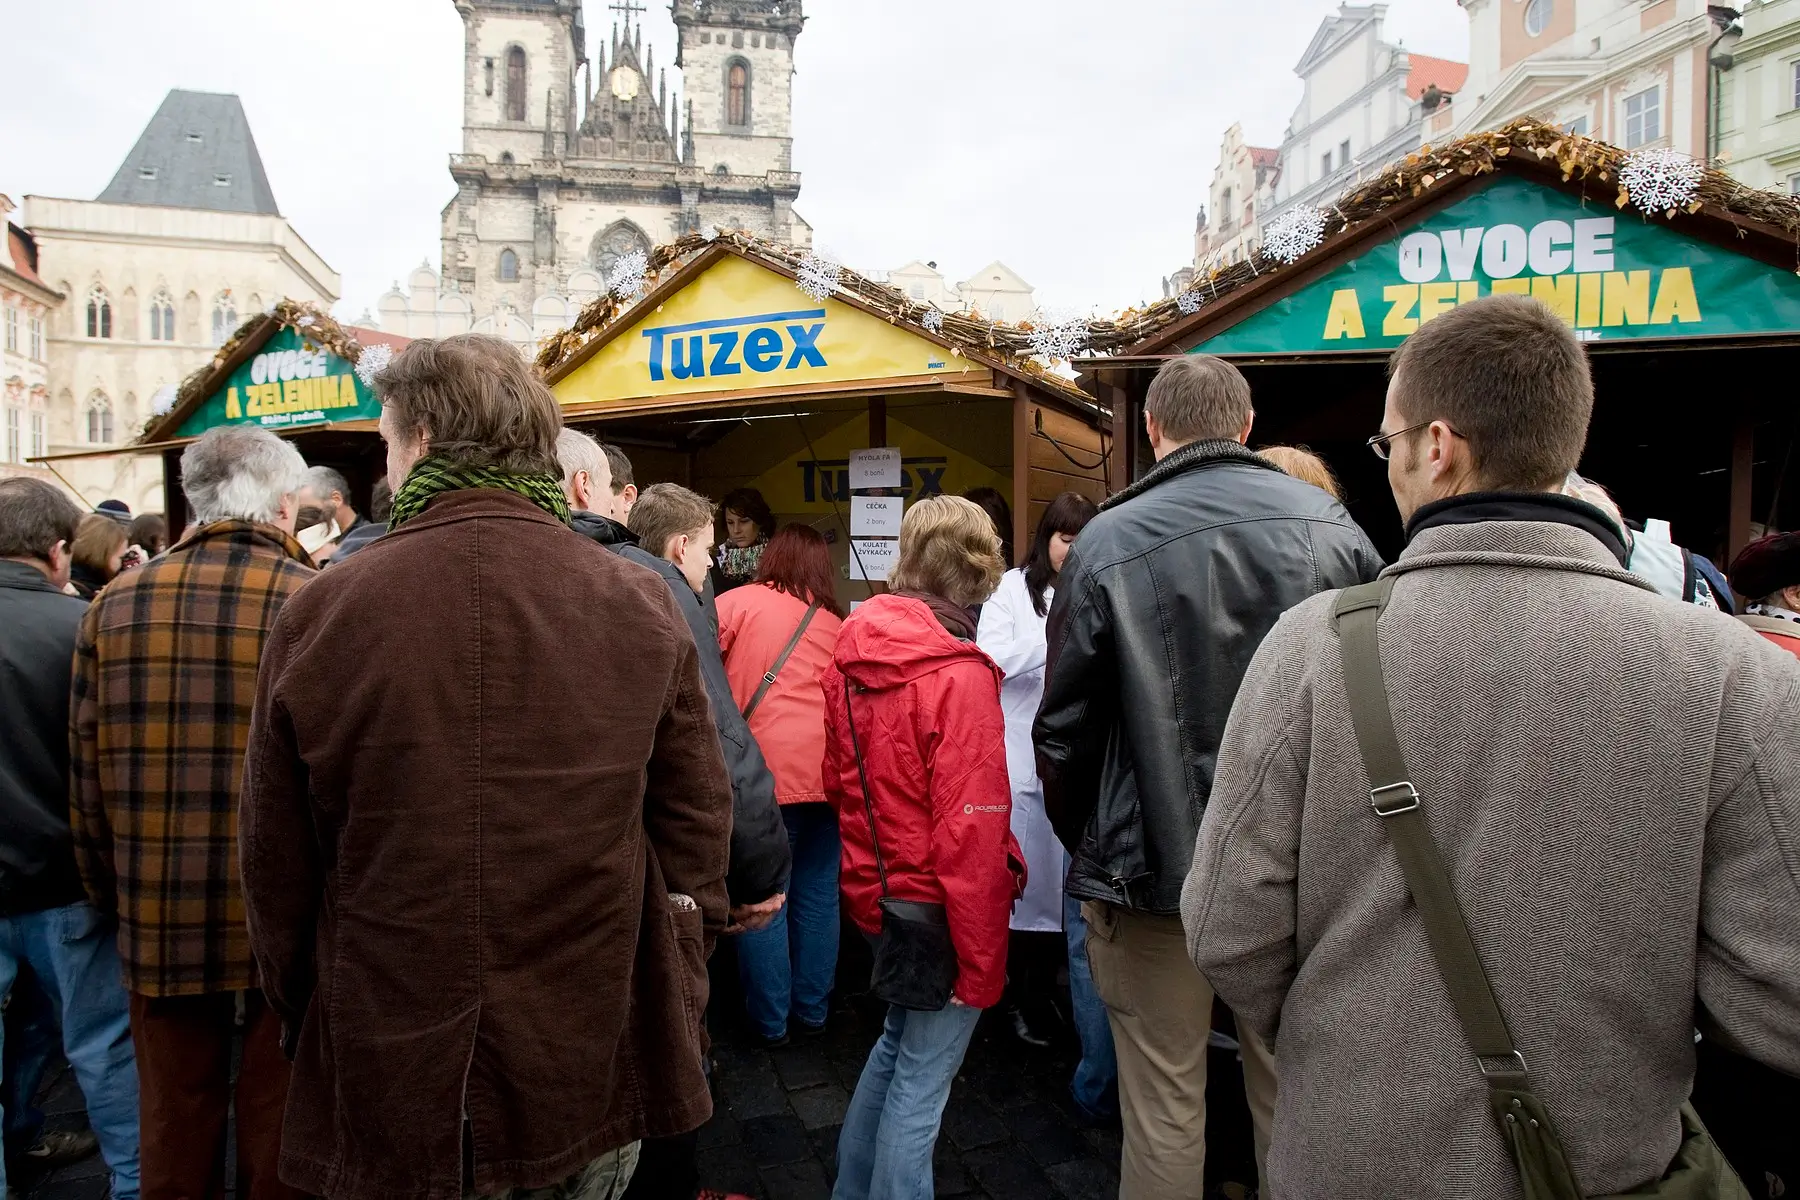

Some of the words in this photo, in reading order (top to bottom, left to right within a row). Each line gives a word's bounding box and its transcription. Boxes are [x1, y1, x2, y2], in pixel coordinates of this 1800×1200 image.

[1399, 216, 1614, 283] OVOCE
[1323, 289, 1366, 340] A
[251, 349, 328, 385] OVOCE
[642, 308, 828, 381] Tuzex
[225, 387, 242, 419] A
[245, 374, 359, 416] ZELENINA
[871, 518, 886, 526] bony
